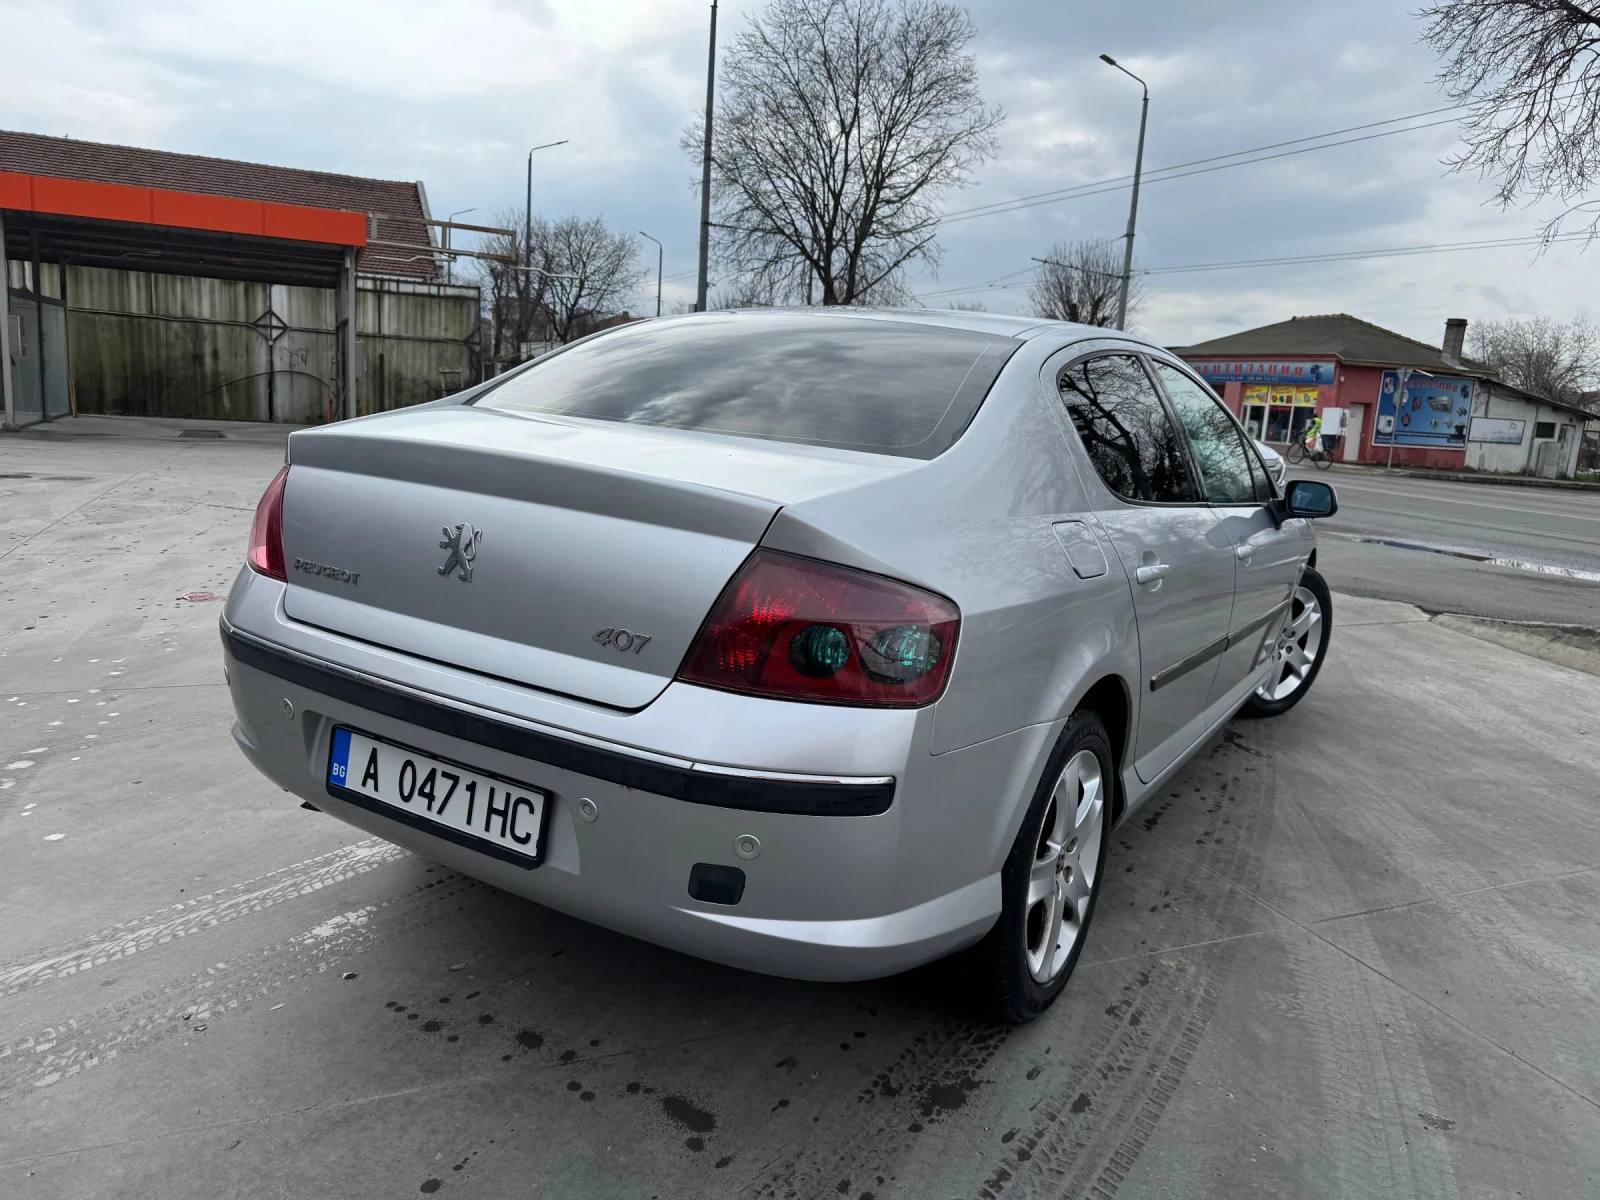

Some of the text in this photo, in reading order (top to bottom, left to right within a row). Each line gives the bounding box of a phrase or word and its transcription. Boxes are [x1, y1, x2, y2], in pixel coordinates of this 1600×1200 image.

[294, 556, 360, 585] PEUGEOT
[591, 626, 652, 654] 407
[332, 763, 346, 778] BG
[361, 747, 379, 792] A
